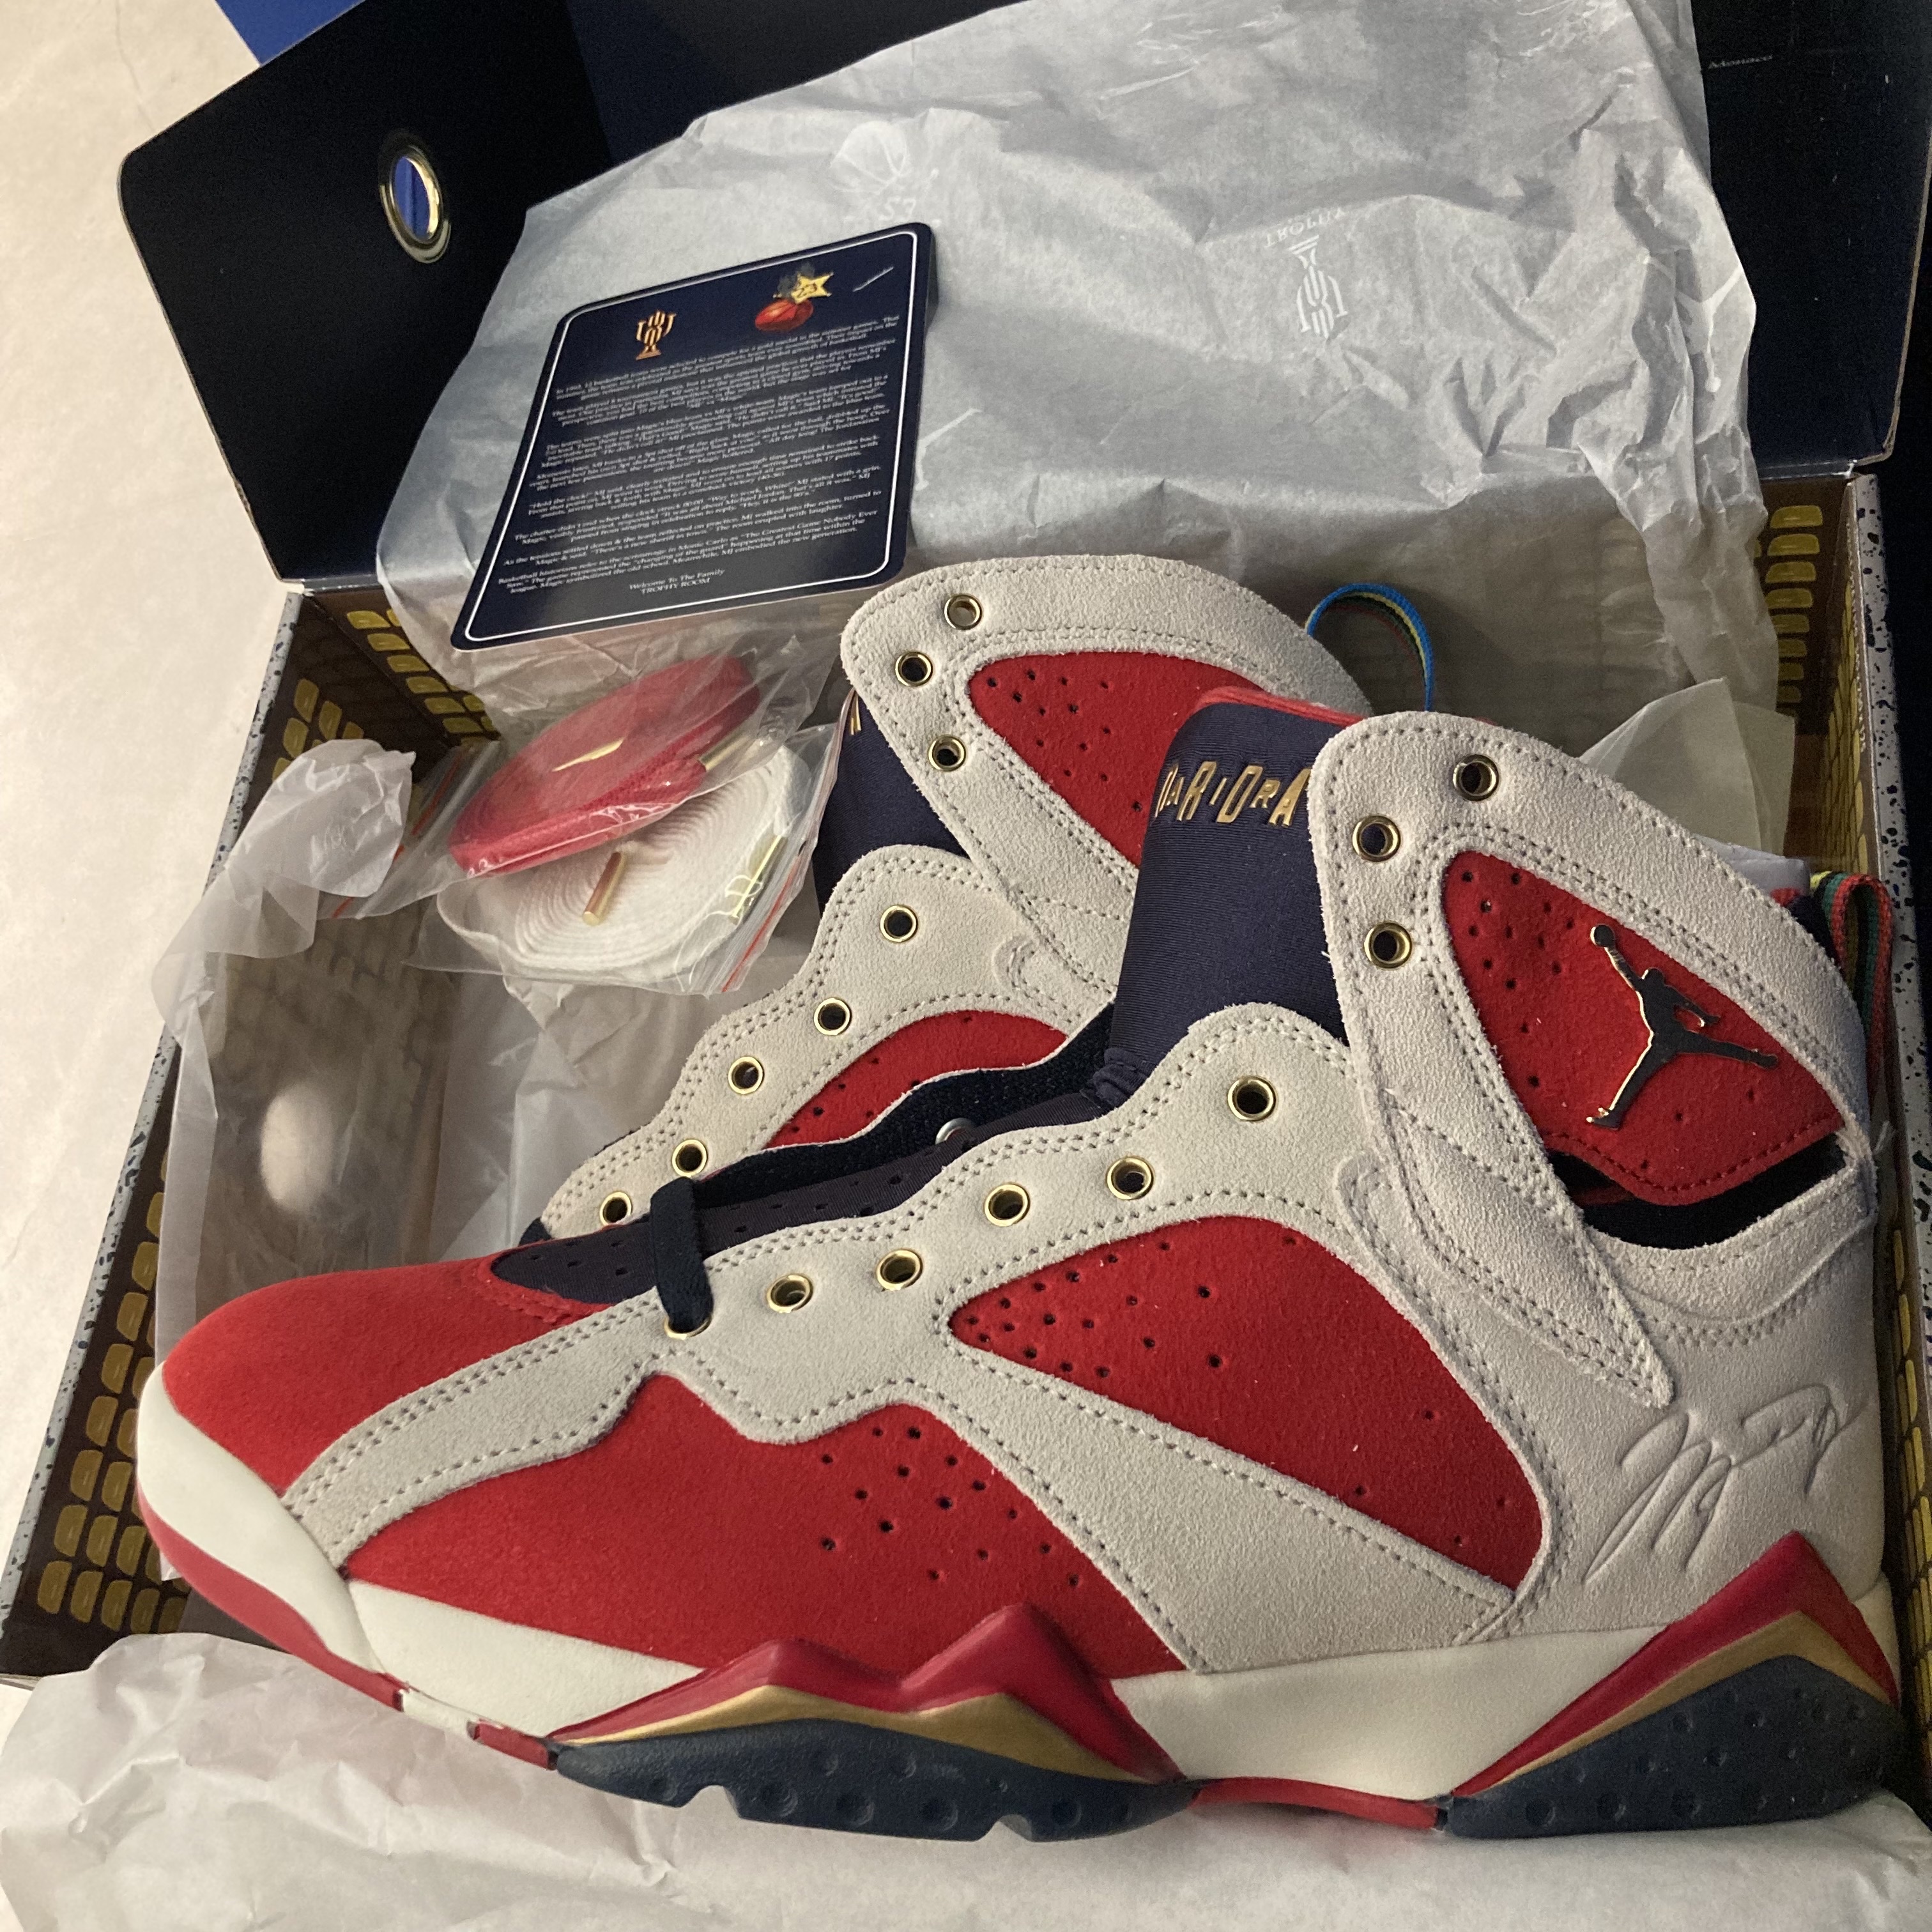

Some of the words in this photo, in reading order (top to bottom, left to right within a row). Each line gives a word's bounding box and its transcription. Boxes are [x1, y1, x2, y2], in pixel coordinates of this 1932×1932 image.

[824, 512, 857, 525] Nobody
[858, 509, 878, 517] Ever
[824, 520, 850, 530] within
[629, 578, 666, 590] Welcome
[696, 568, 725, 579] Family
[640, 581, 680, 593] TROPHY
[680, 576, 710, 586] ROOM
